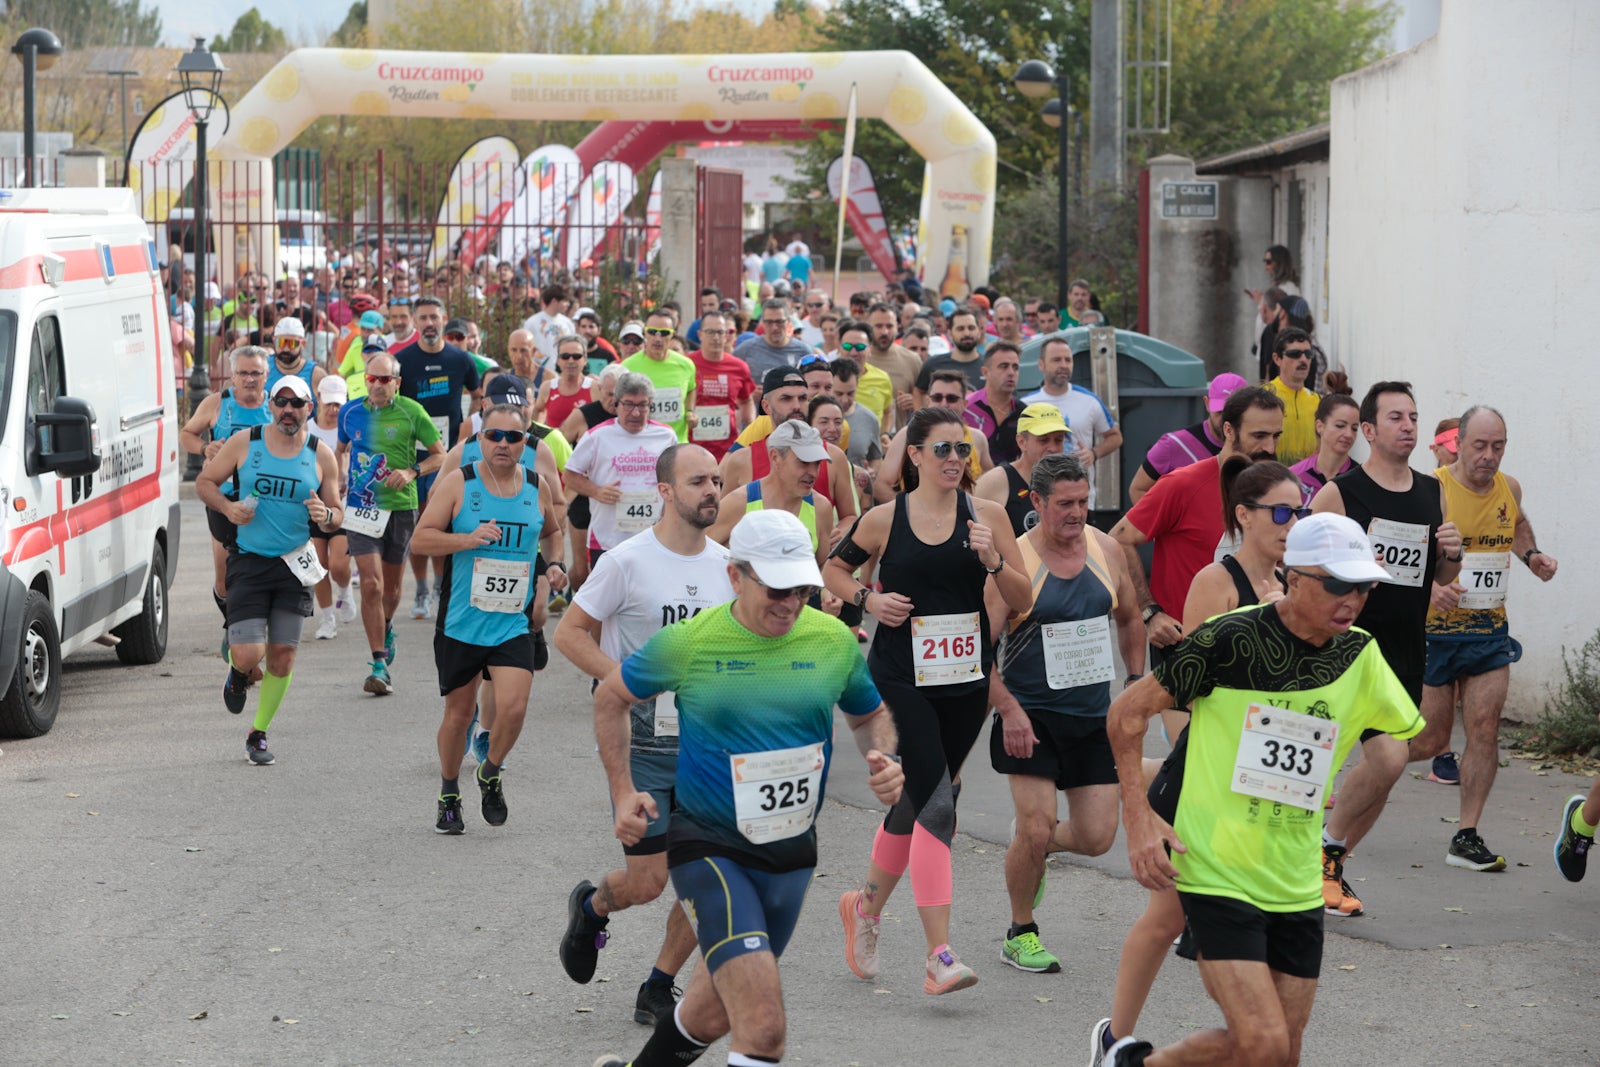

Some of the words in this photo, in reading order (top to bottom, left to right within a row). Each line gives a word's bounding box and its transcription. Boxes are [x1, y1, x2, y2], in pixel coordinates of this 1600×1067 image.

[378, 63, 483, 83] Cruzcampo
[707, 66, 814, 83] Cruzcampo
[388, 85, 439, 103] Radler
[511, 88, 590, 103] DOBLEMENTE
[594, 88, 679, 103] REFRESCANTE
[718, 88, 769, 104] Radler
[1180, 186, 1212, 195] CALLE
[701, 417, 722, 428] 646
[254, 472, 302, 499] GIIT
[354, 508, 380, 521] 863
[626, 505, 653, 517] 443
[485, 576, 519, 594] 537
[1473, 571, 1502, 588] 767
[922, 636, 975, 660] 2165
[1064, 649, 1083, 660] CORRO
[1083, 645, 1103, 657] CONTRA
[1260, 740, 1313, 775] 333
[759, 777, 809, 811] 325
